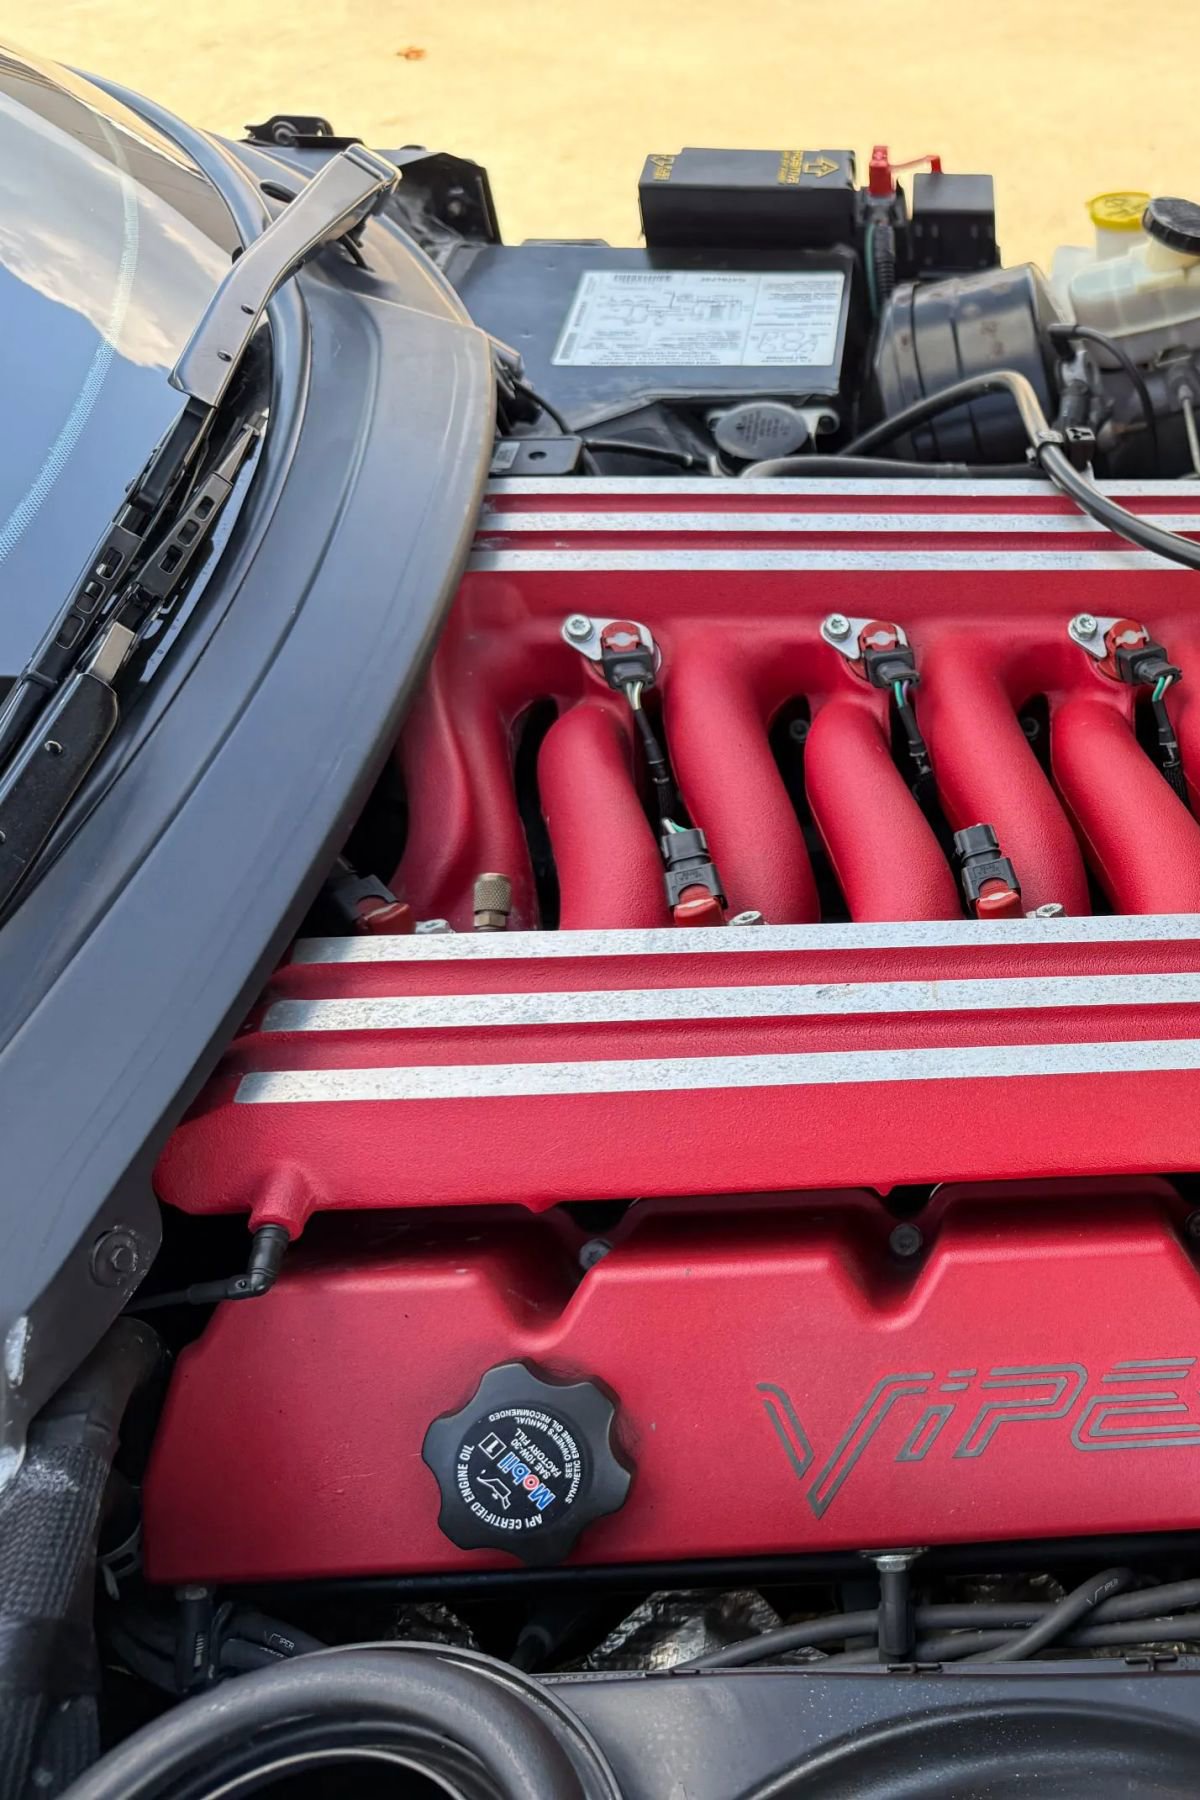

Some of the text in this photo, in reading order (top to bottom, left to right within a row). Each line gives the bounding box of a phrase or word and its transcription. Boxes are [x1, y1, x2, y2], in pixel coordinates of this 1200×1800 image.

[488, 1408, 581, 1504] SYNTHETIC ENGINE OIL RECOMMENDED
[510, 1438, 551, 1480] SAE 10W-30
[513, 1428, 562, 1478] FACTORY FILL
[514, 1417, 573, 1479] SEE OWNER'S MANUAL
[457, 1444, 542, 1530] API CERTIFIED ENGINE OIL
[496, 1451, 556, 1511] Mobil
